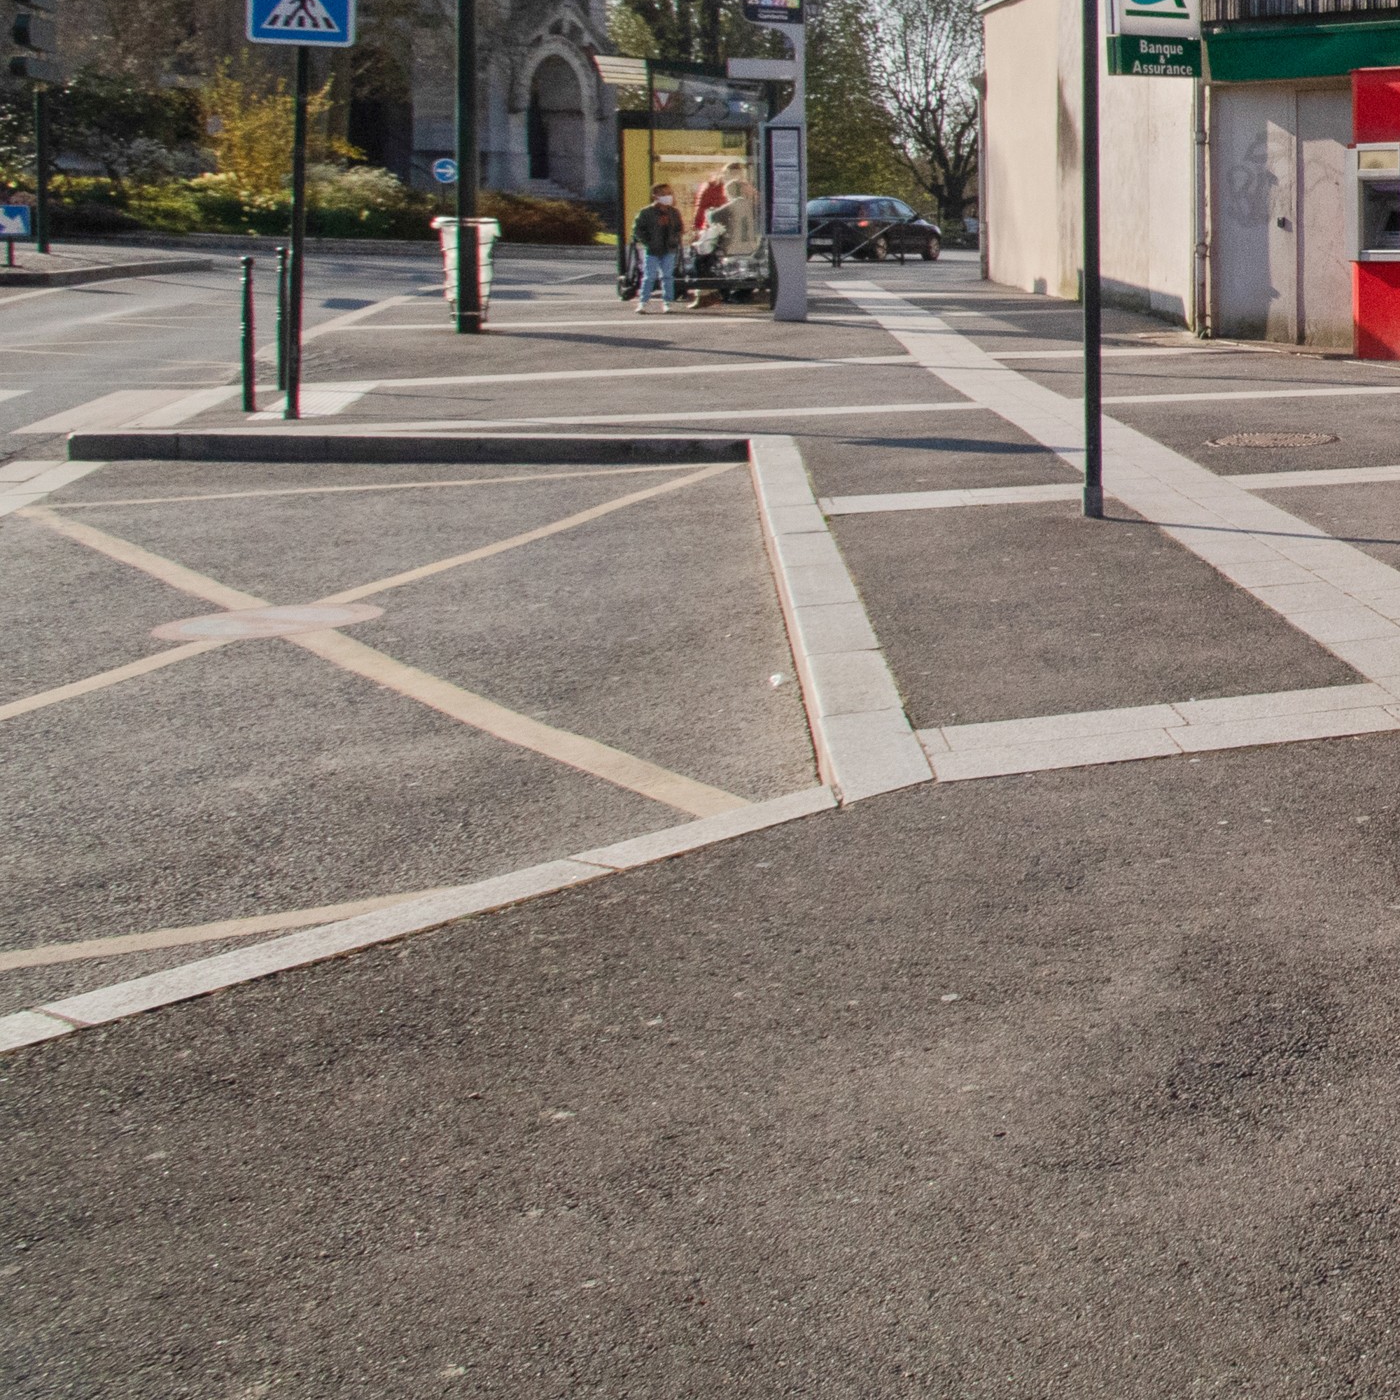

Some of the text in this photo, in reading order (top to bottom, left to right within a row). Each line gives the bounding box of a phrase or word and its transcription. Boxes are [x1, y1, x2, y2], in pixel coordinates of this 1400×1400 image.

[1139, 40, 1184, 58] Banque
[1159, 55, 1166, 64] &
[1132, 60, 1193, 75] Assurance
